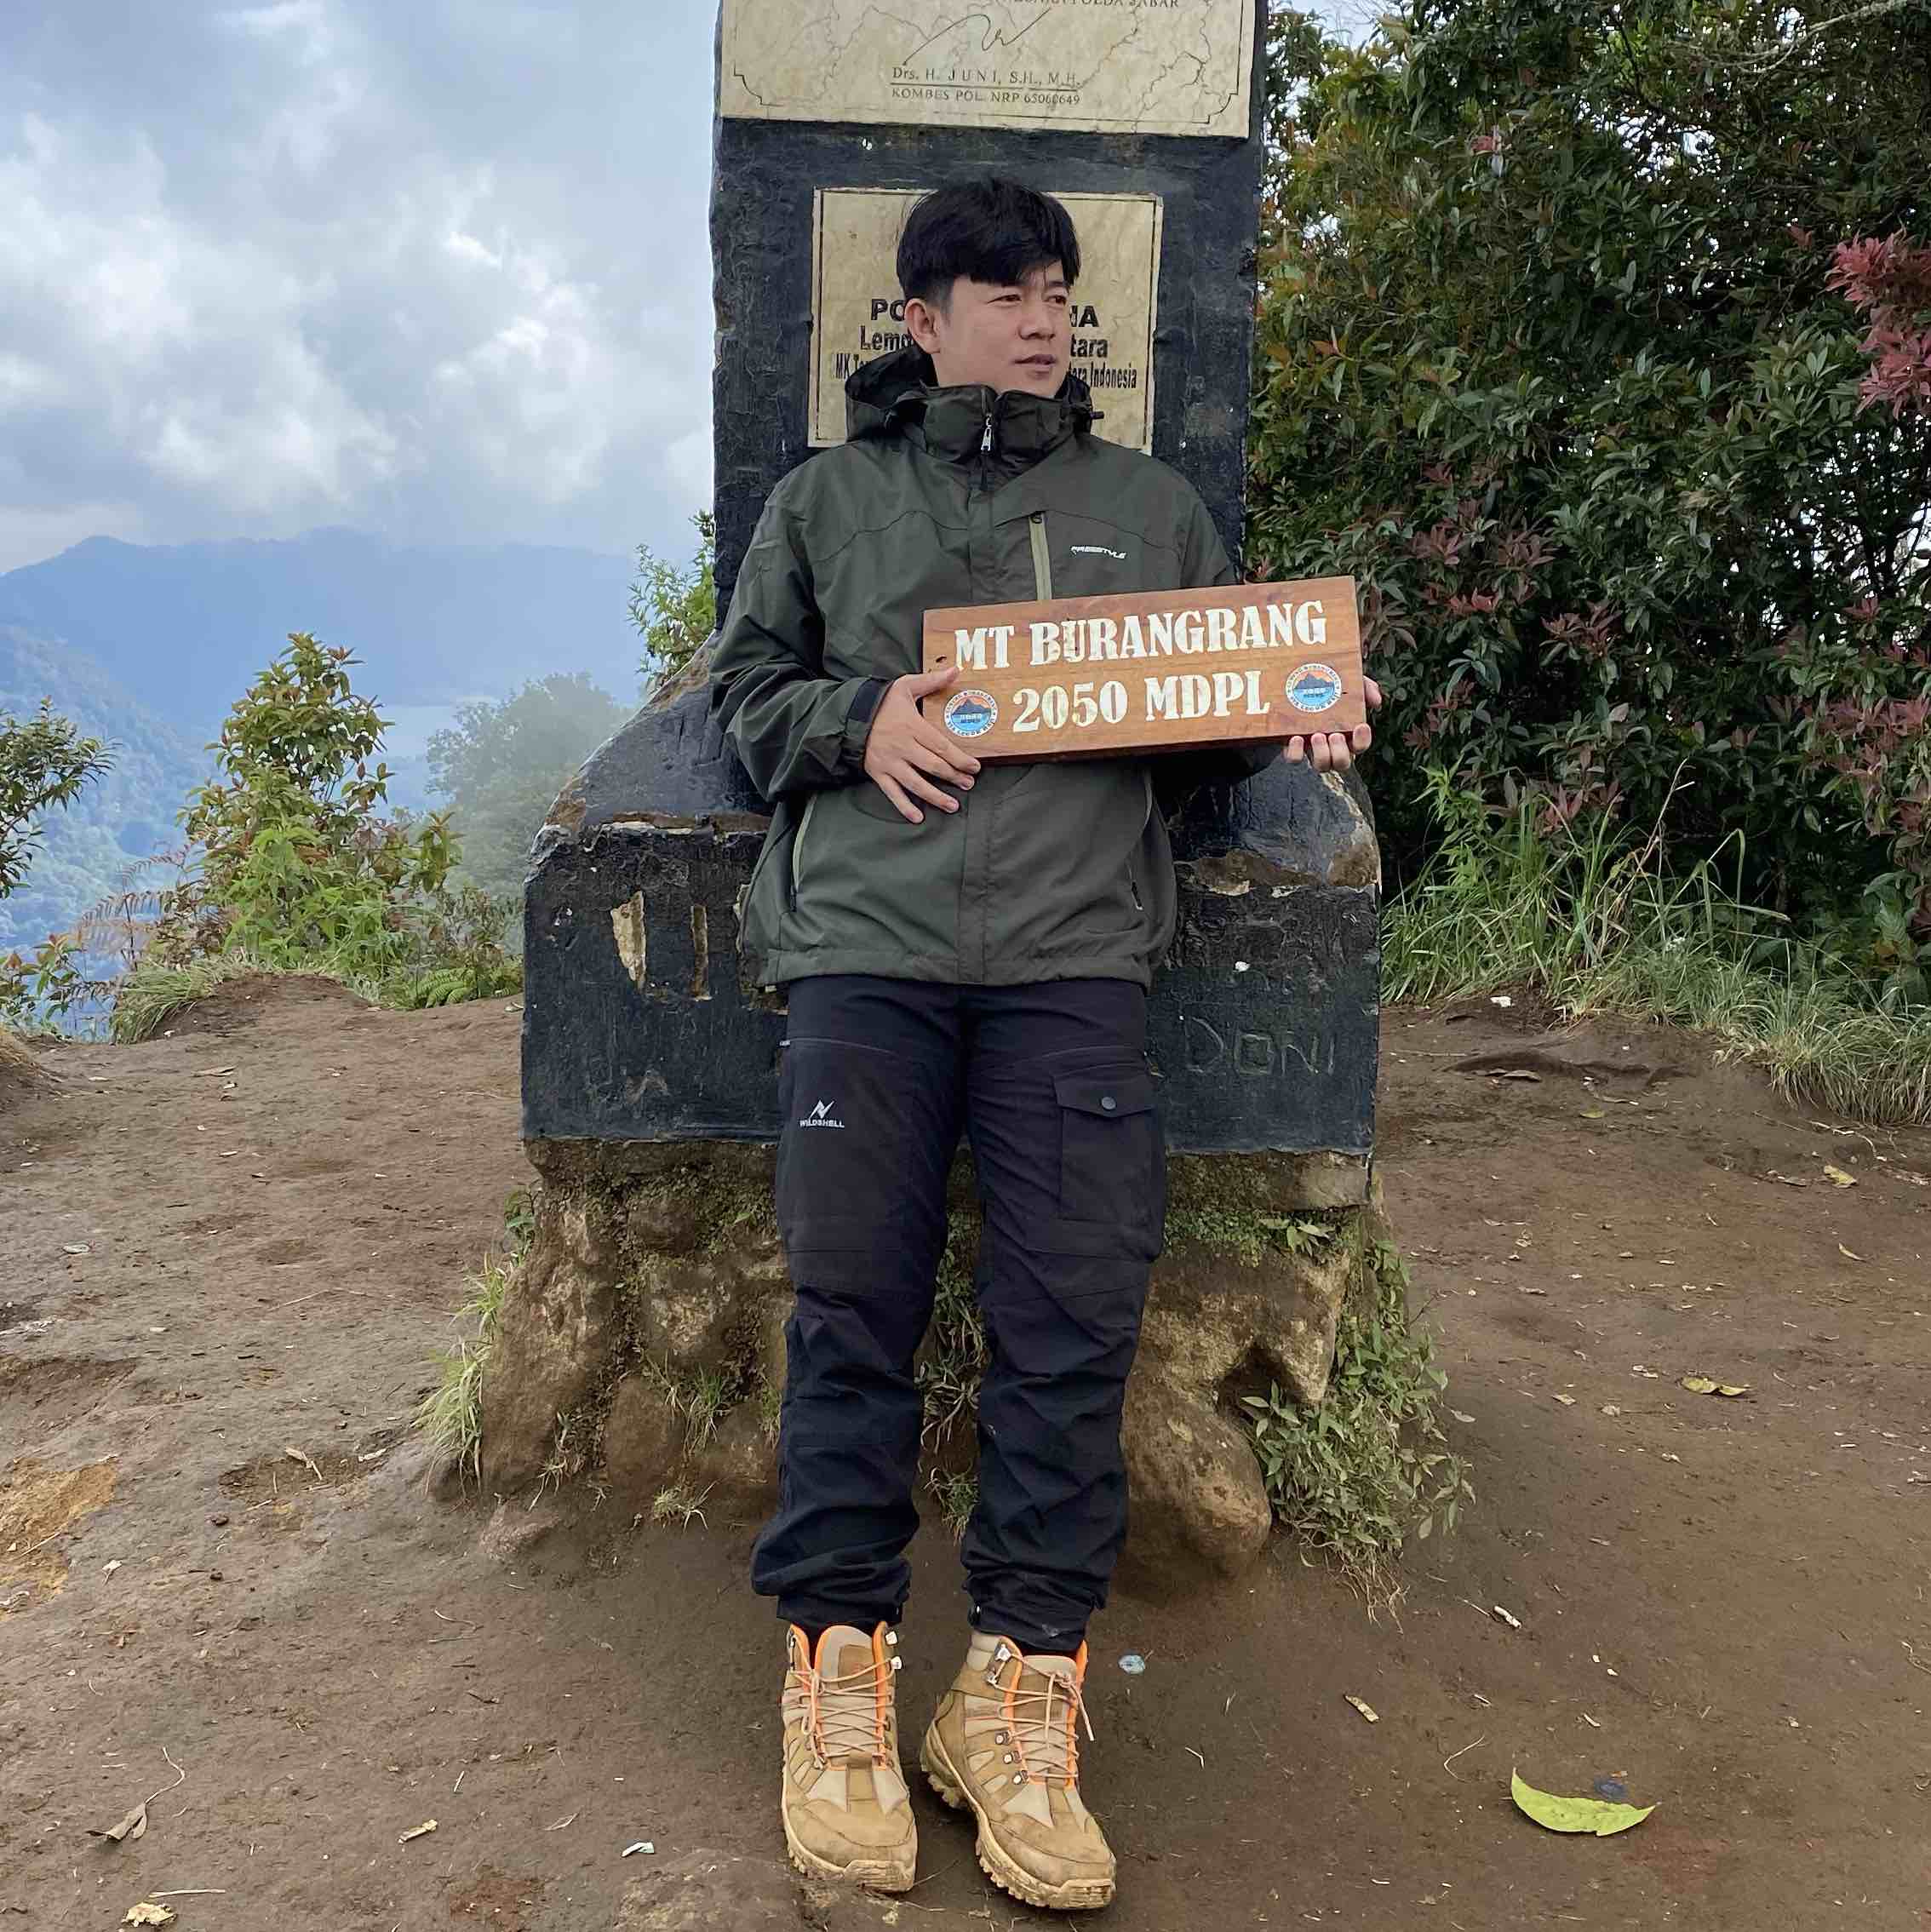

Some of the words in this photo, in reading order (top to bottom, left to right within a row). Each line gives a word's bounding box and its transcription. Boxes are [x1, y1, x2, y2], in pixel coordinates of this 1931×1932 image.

[891, 66, 920, 80] Drs.
[891, 88, 949, 100] KOMBES
[990, 91, 1020, 102] NRP
[1090, 361, 1137, 389] Indonesia
[954, 625, 1015, 671] MT
[1029, 599, 1327, 667] BURANGRANG
[1012, 680, 1128, 733] 2050
[1143, 670, 1271, 722] MDPL
[799, 1118, 845, 1128] WILDSHELL
